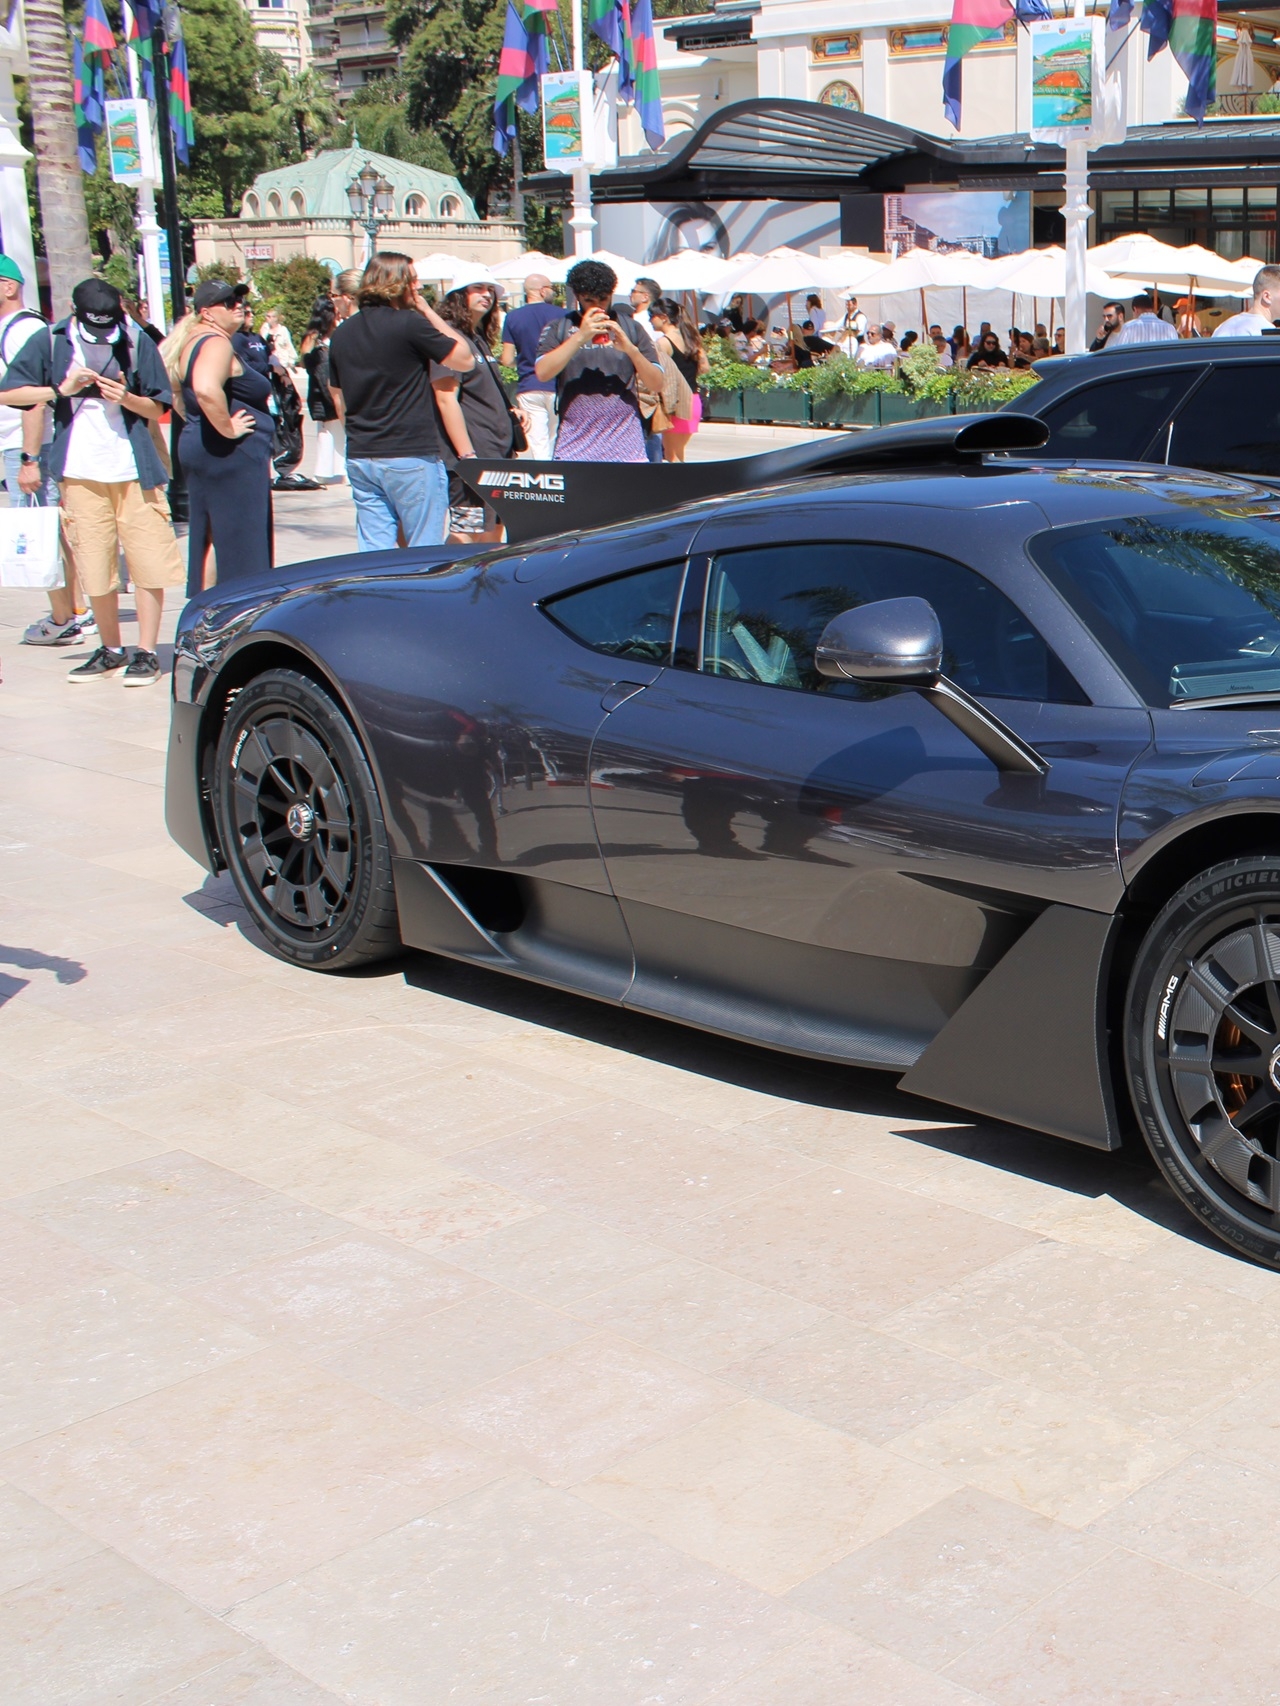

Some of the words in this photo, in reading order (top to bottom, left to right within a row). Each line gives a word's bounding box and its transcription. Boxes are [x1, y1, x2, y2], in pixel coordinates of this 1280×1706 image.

[245, 248, 271, 256] POLICE
[504, 471, 565, 491] AMG
[490, 489, 502, 499] E
[503, 490, 566, 503] PERFORMANCE
[1218, 1222, 1245, 1242] CUP
